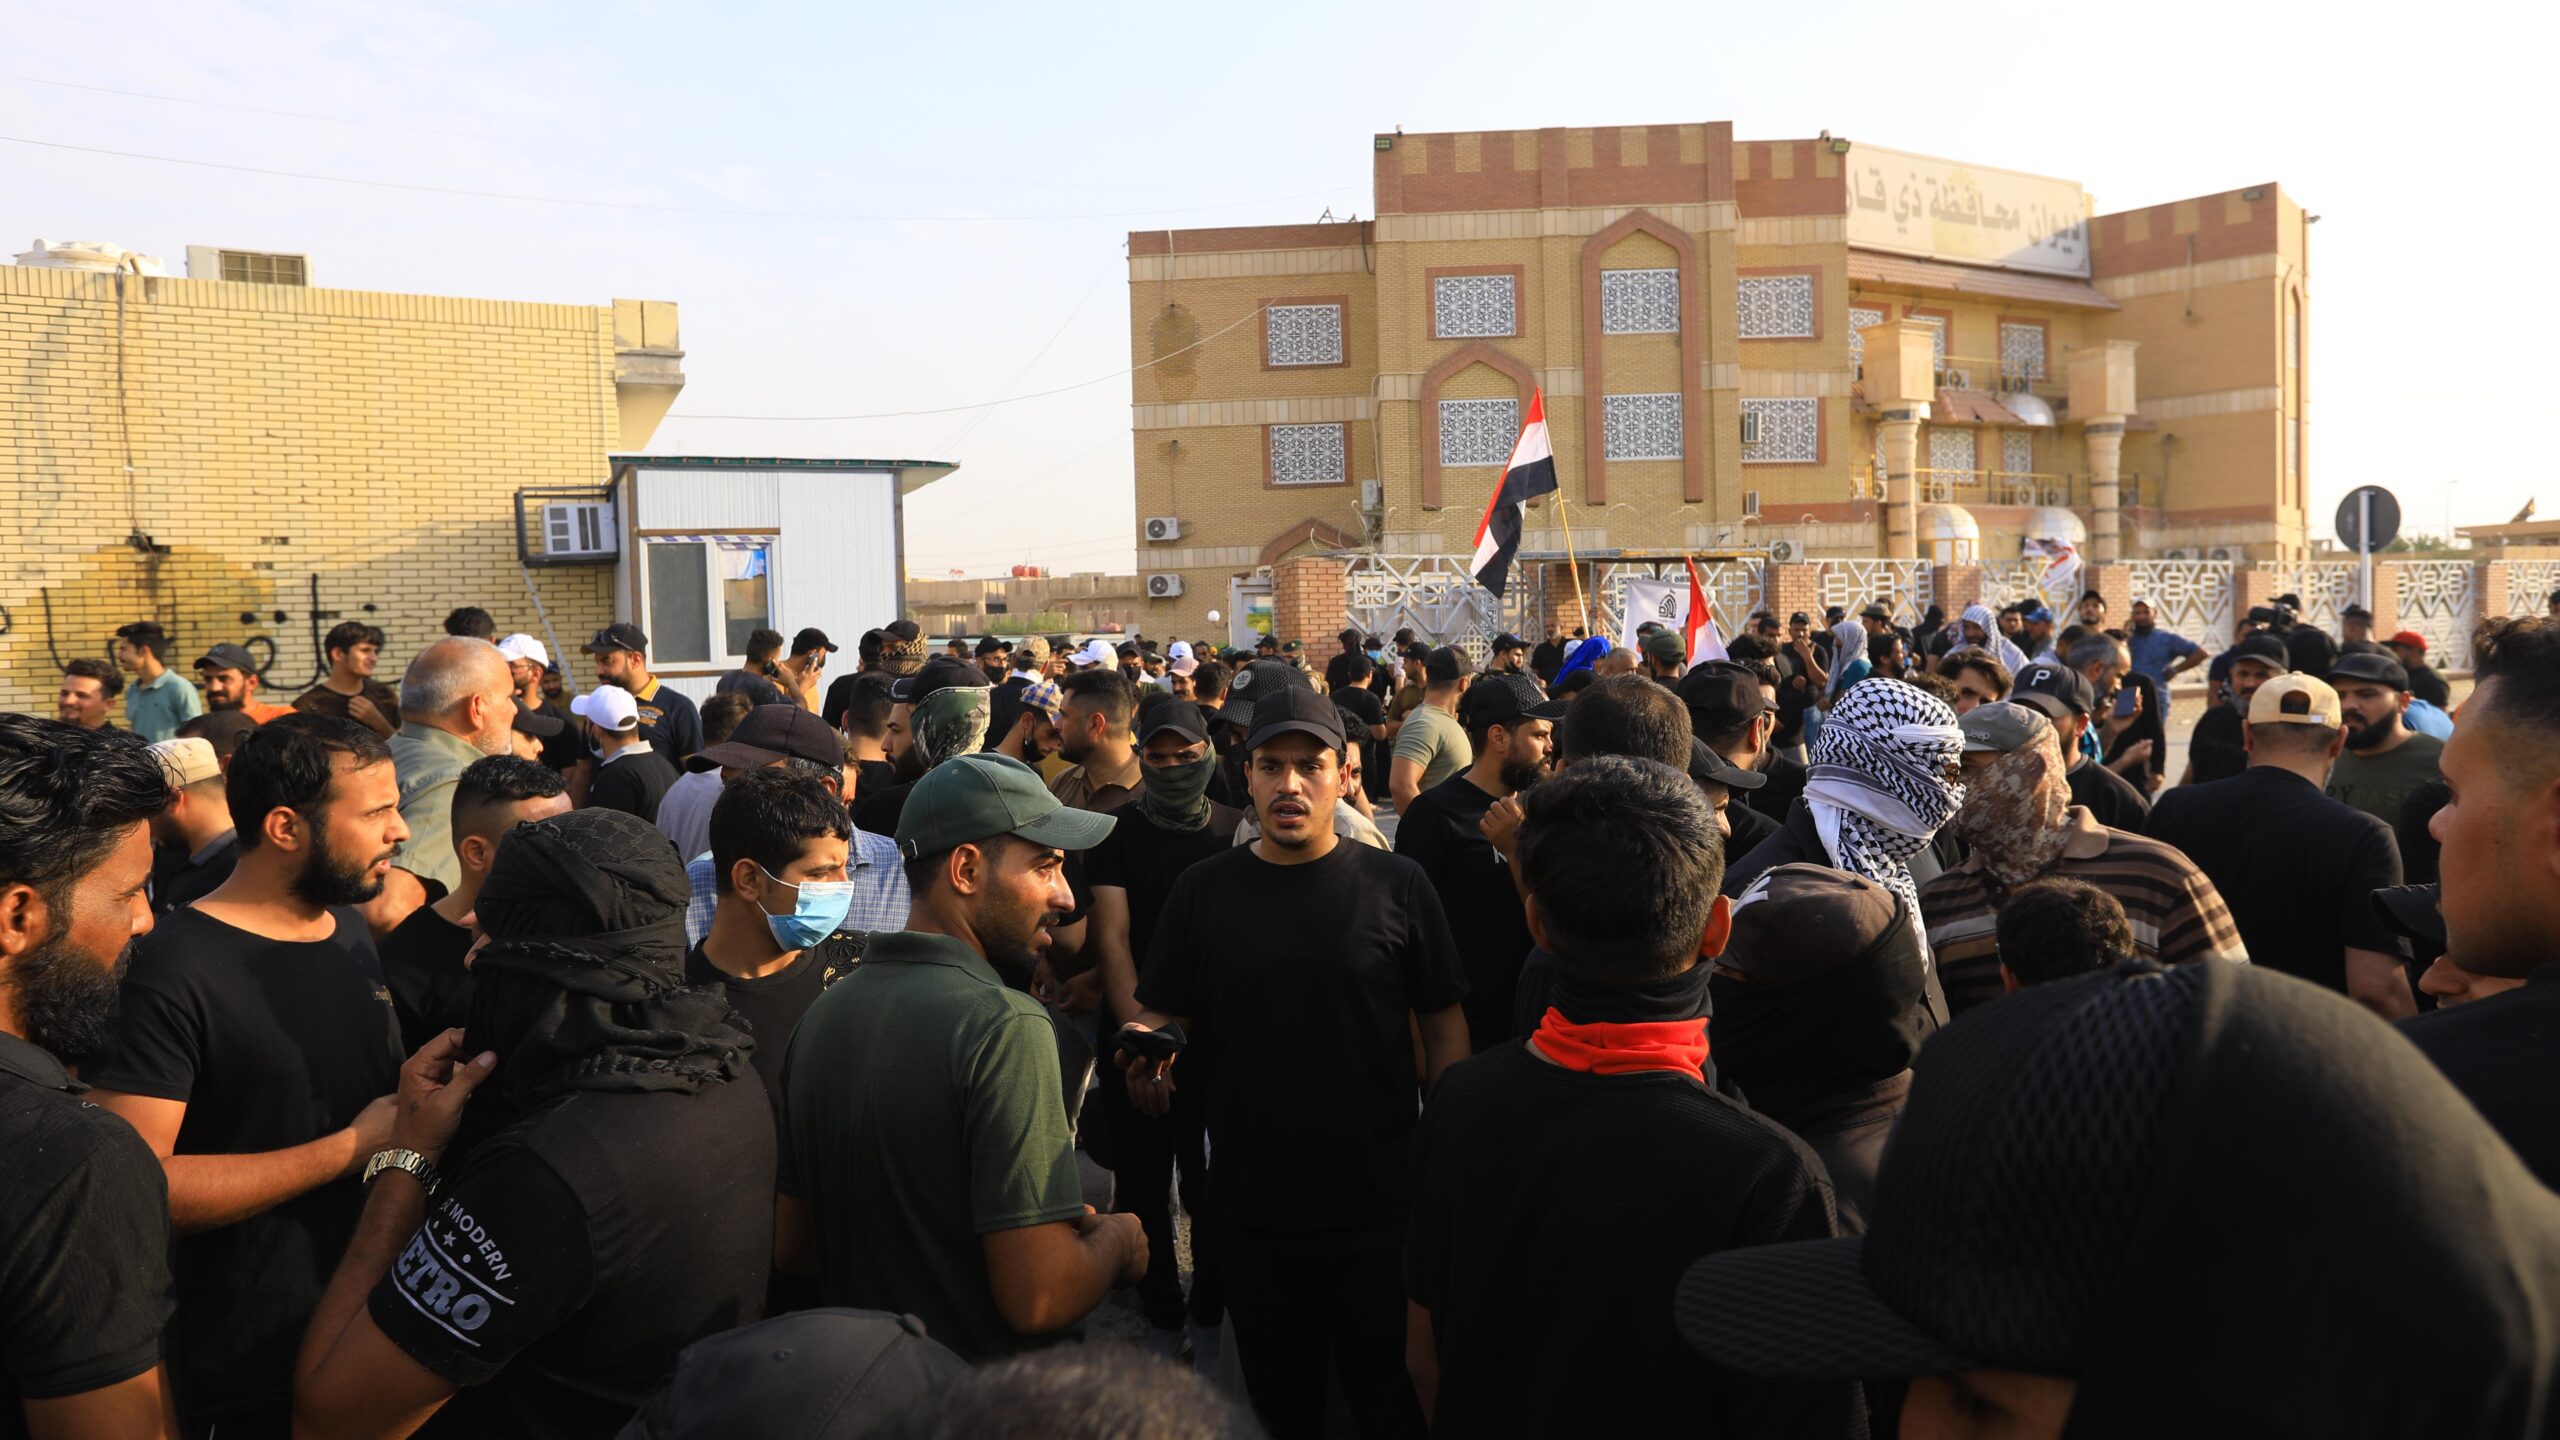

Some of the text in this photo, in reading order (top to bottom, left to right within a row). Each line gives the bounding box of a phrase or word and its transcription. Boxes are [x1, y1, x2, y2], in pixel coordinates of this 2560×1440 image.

[1892, 173, 1922, 233] ذي
[1926, 178, 2020, 230] محافظة
[2028, 202, 2081, 254] ديوان
[2031, 670, 2051, 686] P
[1966, 729, 1991, 741] Jeep
[449, 1203, 512, 1281] MODERN
[398, 1235, 491, 1331] ETRO
